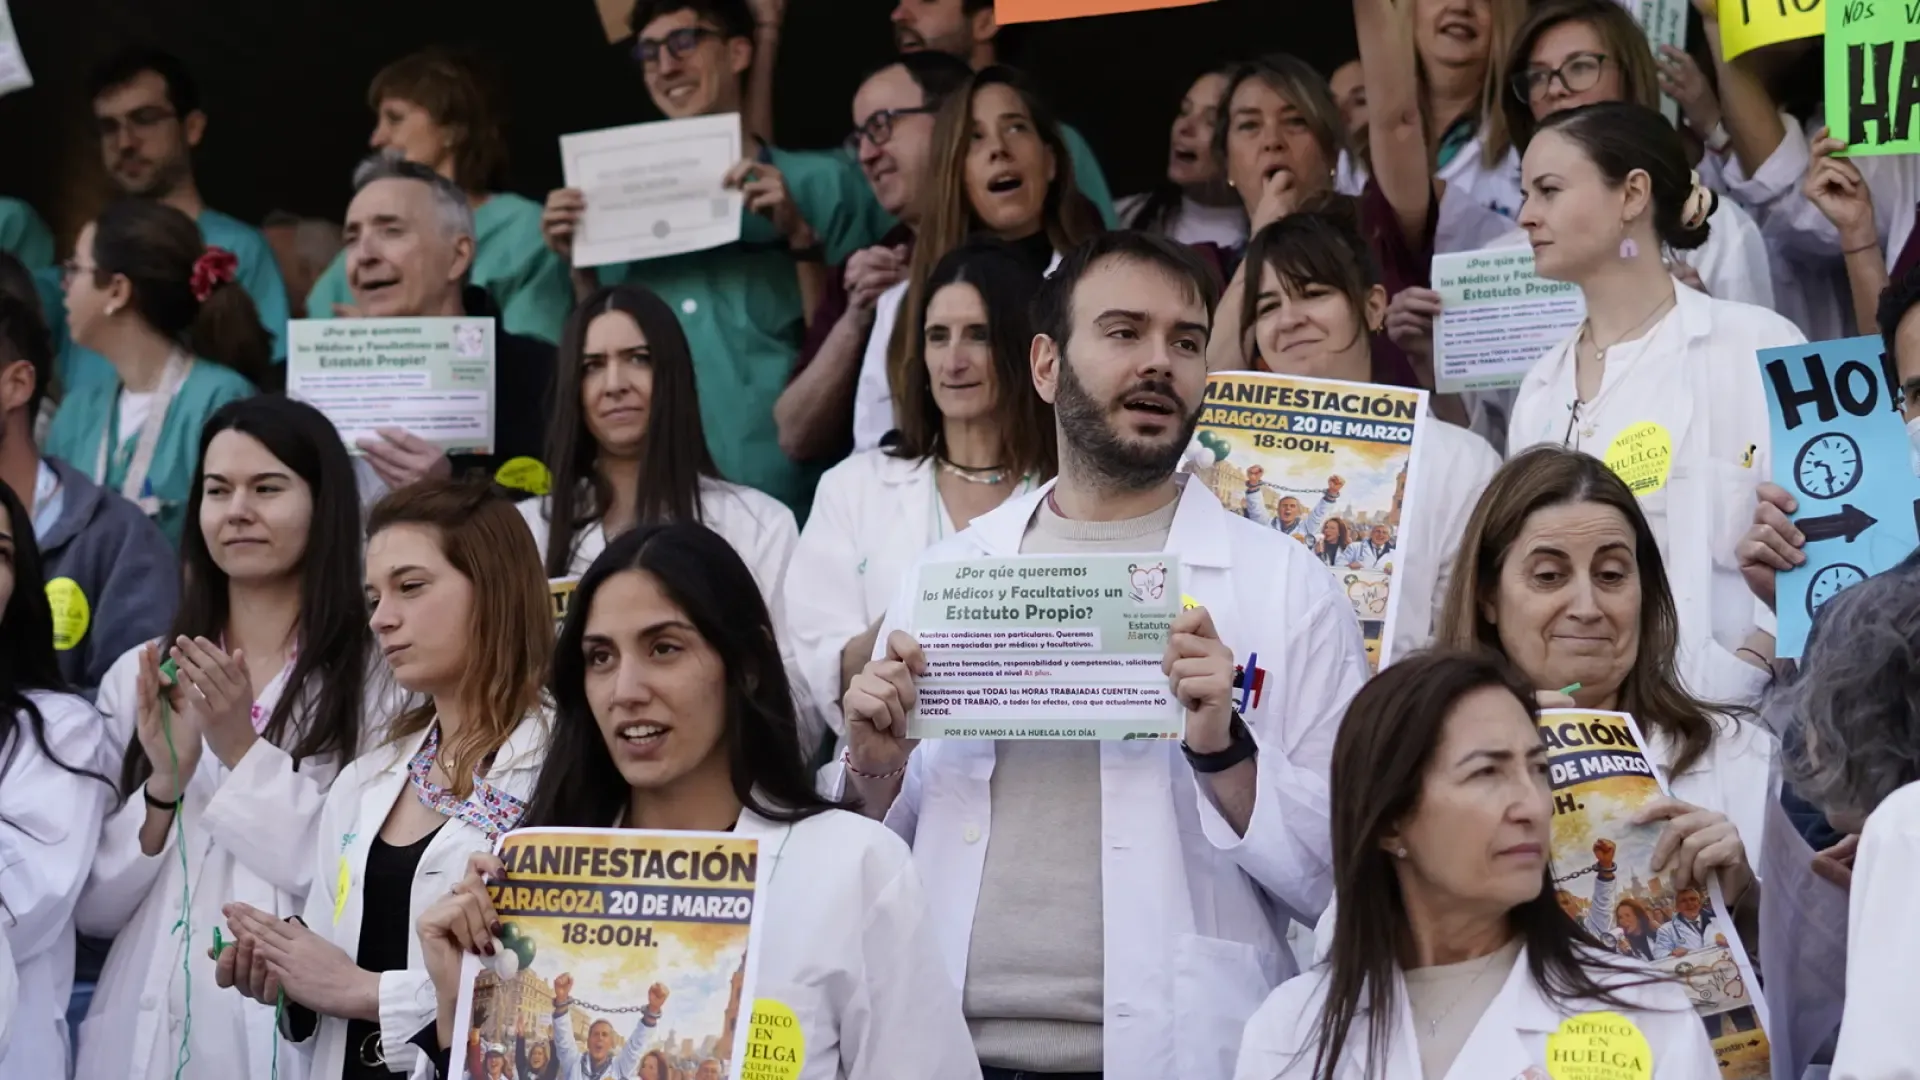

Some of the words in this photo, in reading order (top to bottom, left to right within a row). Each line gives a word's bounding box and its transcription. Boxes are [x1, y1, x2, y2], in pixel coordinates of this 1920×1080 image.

[1843, 1, 1875, 27] NOS
[1463, 286, 1523, 302] Estatuto
[1525, 281, 1576, 297] Propio
[1200, 409, 1289, 430] ARAGOZA
[1292, 415, 1316, 433] 20
[1320, 420, 1342, 435] DE
[1345, 422, 1412, 442] MARZO
[1252, 433, 1335, 454] 18:00H.
[955, 566, 985, 579] ¿Por
[1018, 566, 1087, 580] queremos
[922, 589, 939, 601] los
[942, 587, 994, 600] Médicos
[998, 589, 1007, 601] y
[1011, 585, 1100, 599] Facultativos
[1104, 587, 1123, 598] un
[945, 604, 1020, 620] Estatuto
[1025, 603, 1094, 623] Propio?
[1128, 621, 1170, 630] Estatuto
[1056, 630, 1094, 639] Queremos
[951, 642, 992, 650] negociadas
[1008, 641, 1038, 649] médicos
[1003, 659, 1062, 669] responsabilidad
[982, 687, 1008, 695] TODAS
[1021, 687, 1049, 695] HORAS
[1050, 687, 1100, 695] TRABAJADAS
[1101, 687, 1138, 695] CUENTEN
[1078, 727, 1096, 736] DÍAS
[1550, 760, 1580, 784] DE
[1580, 755, 1650, 777] MARZO
[488, 885, 605, 914] ZARAGOZA
[609, 890, 638, 916] 20
[642, 893, 668, 915] DE
[672, 894, 751, 919] MARZO
[561, 922, 659, 948] 18:00H.
[750, 1011, 793, 1028] ÉDICO
[755, 1028, 773, 1040] EN
[1588, 1036, 1610, 1048] EN
[1553, 1049, 1643, 1072] HUELGA
